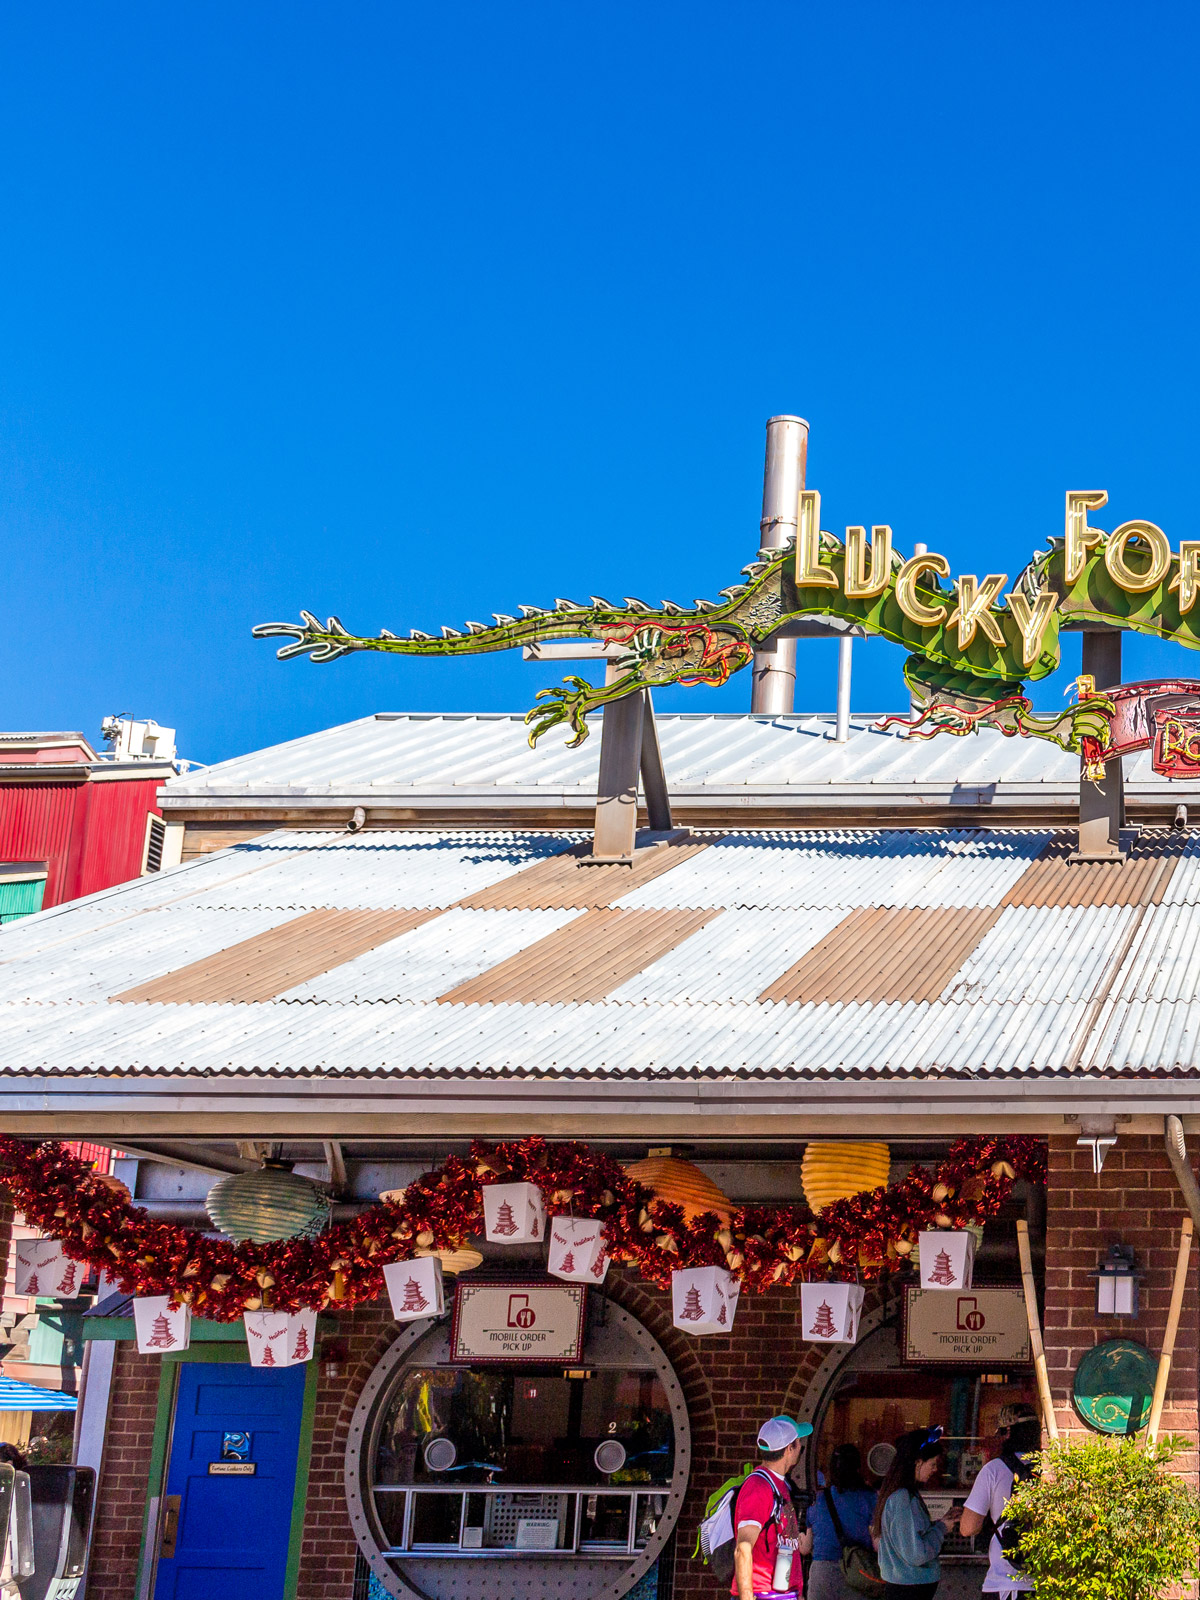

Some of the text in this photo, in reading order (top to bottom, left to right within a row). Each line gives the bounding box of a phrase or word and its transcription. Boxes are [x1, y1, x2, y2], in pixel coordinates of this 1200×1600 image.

[795, 490, 1059, 668] LUCKY
[553, 1232, 596, 1247] Happy Holidays
[17, 1254, 58, 1269] Happy Holidays
[248, 1327, 288, 1341] Happy Holidays
[490, 1333, 547, 1341] MOBILE ORDER
[940, 1335, 997, 1344] MOBILE ORDER
[502, 1343, 532, 1351] PICK UP
[953, 1345, 983, 1353] PICK UP
[608, 1422, 617, 1433] 2
